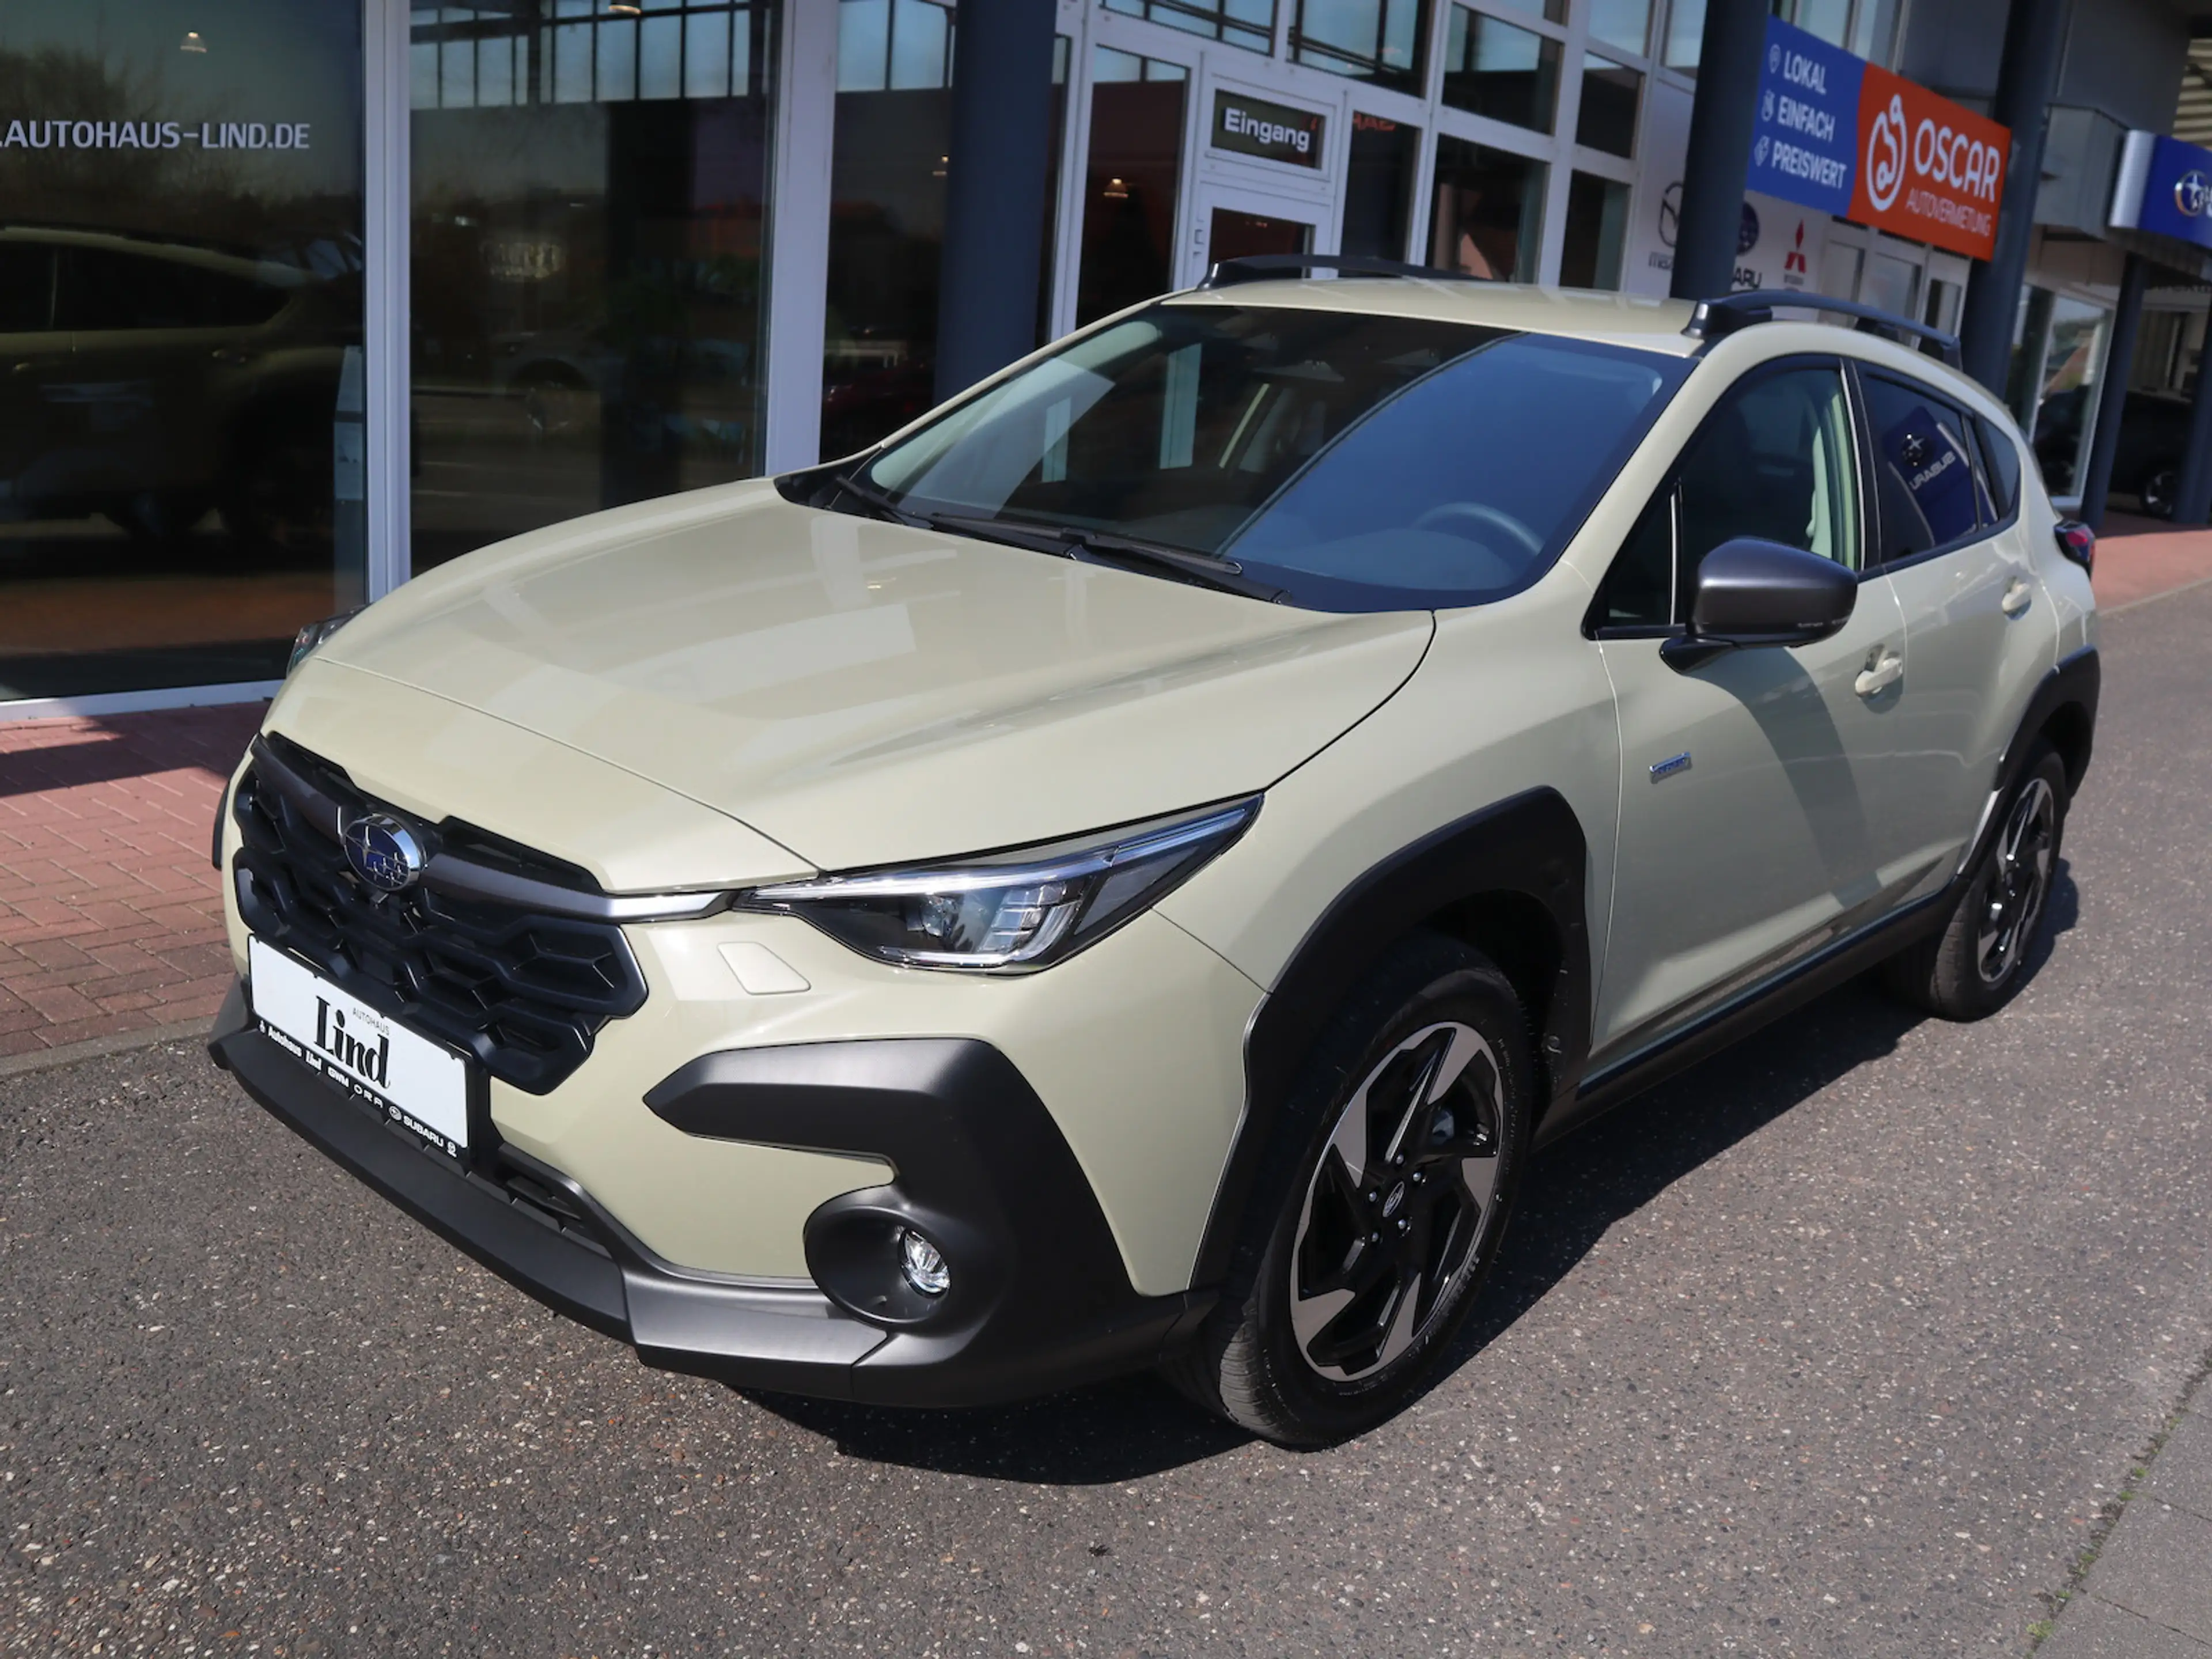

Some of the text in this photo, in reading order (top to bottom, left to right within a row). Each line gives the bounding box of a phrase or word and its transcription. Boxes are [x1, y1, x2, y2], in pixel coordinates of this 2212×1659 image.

[1783, 50, 1827, 96] LOKAL
[1224, 107, 1310, 153] Eingang
[1777, 94, 1836, 143] EINFACH
[1771, 140, 1847, 190] PREISWERT
[1912, 117, 2001, 204] OSCAR
[313, 995, 391, 1089] Lind
[352, 1007, 391, 1036] AUTOHAUS
[267, 1025, 302, 1058] Autohaus
[304, 1049, 323, 1071] Lind
[353, 1084, 384, 1109] ORA
[403, 1115, 445, 1148] SUBARU
